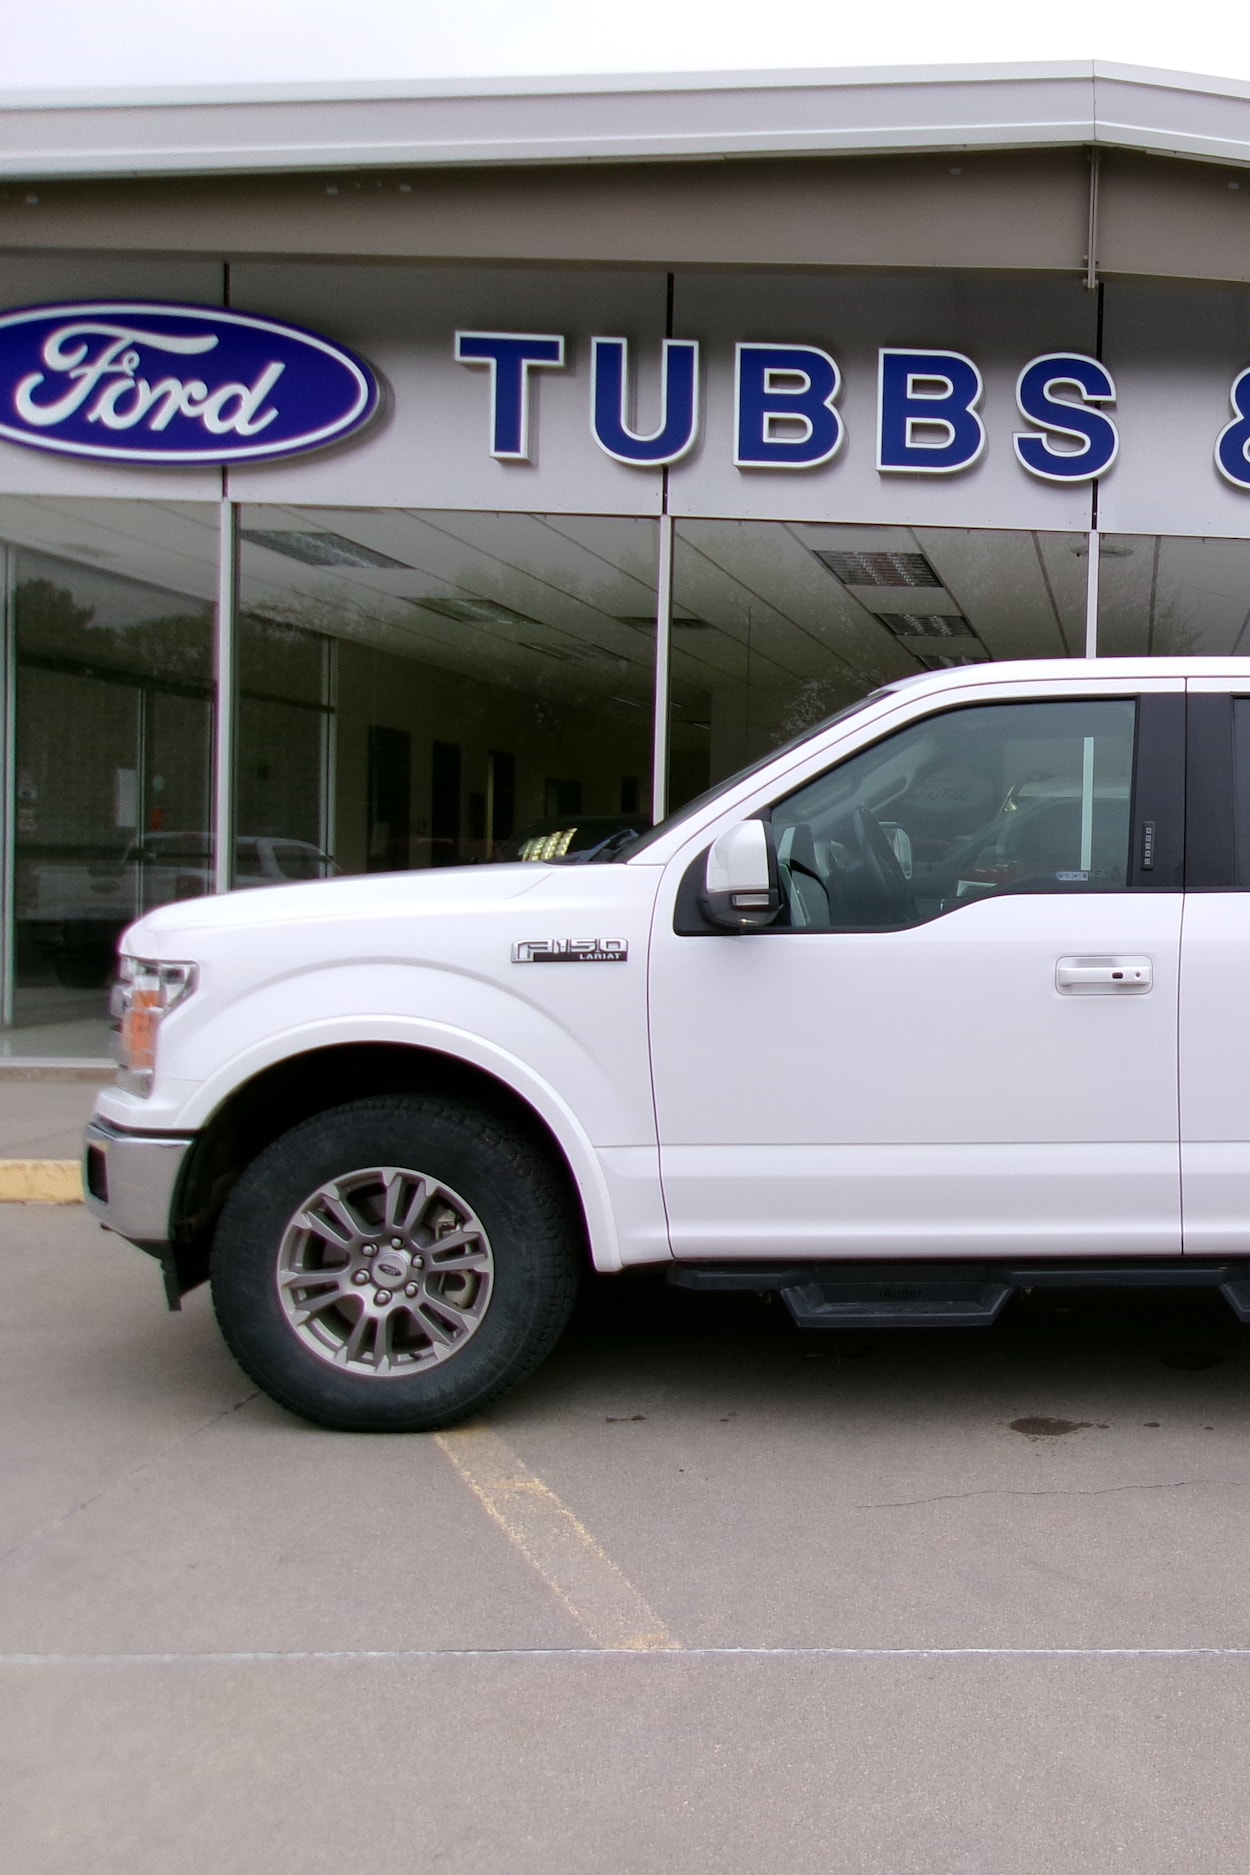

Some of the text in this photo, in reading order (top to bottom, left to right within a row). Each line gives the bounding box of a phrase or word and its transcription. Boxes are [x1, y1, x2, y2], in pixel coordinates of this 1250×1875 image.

[14, 323, 286, 436] Ford
[454, 330, 1120, 482] TUBBS
[579, 953, 622, 961] LARIAT
